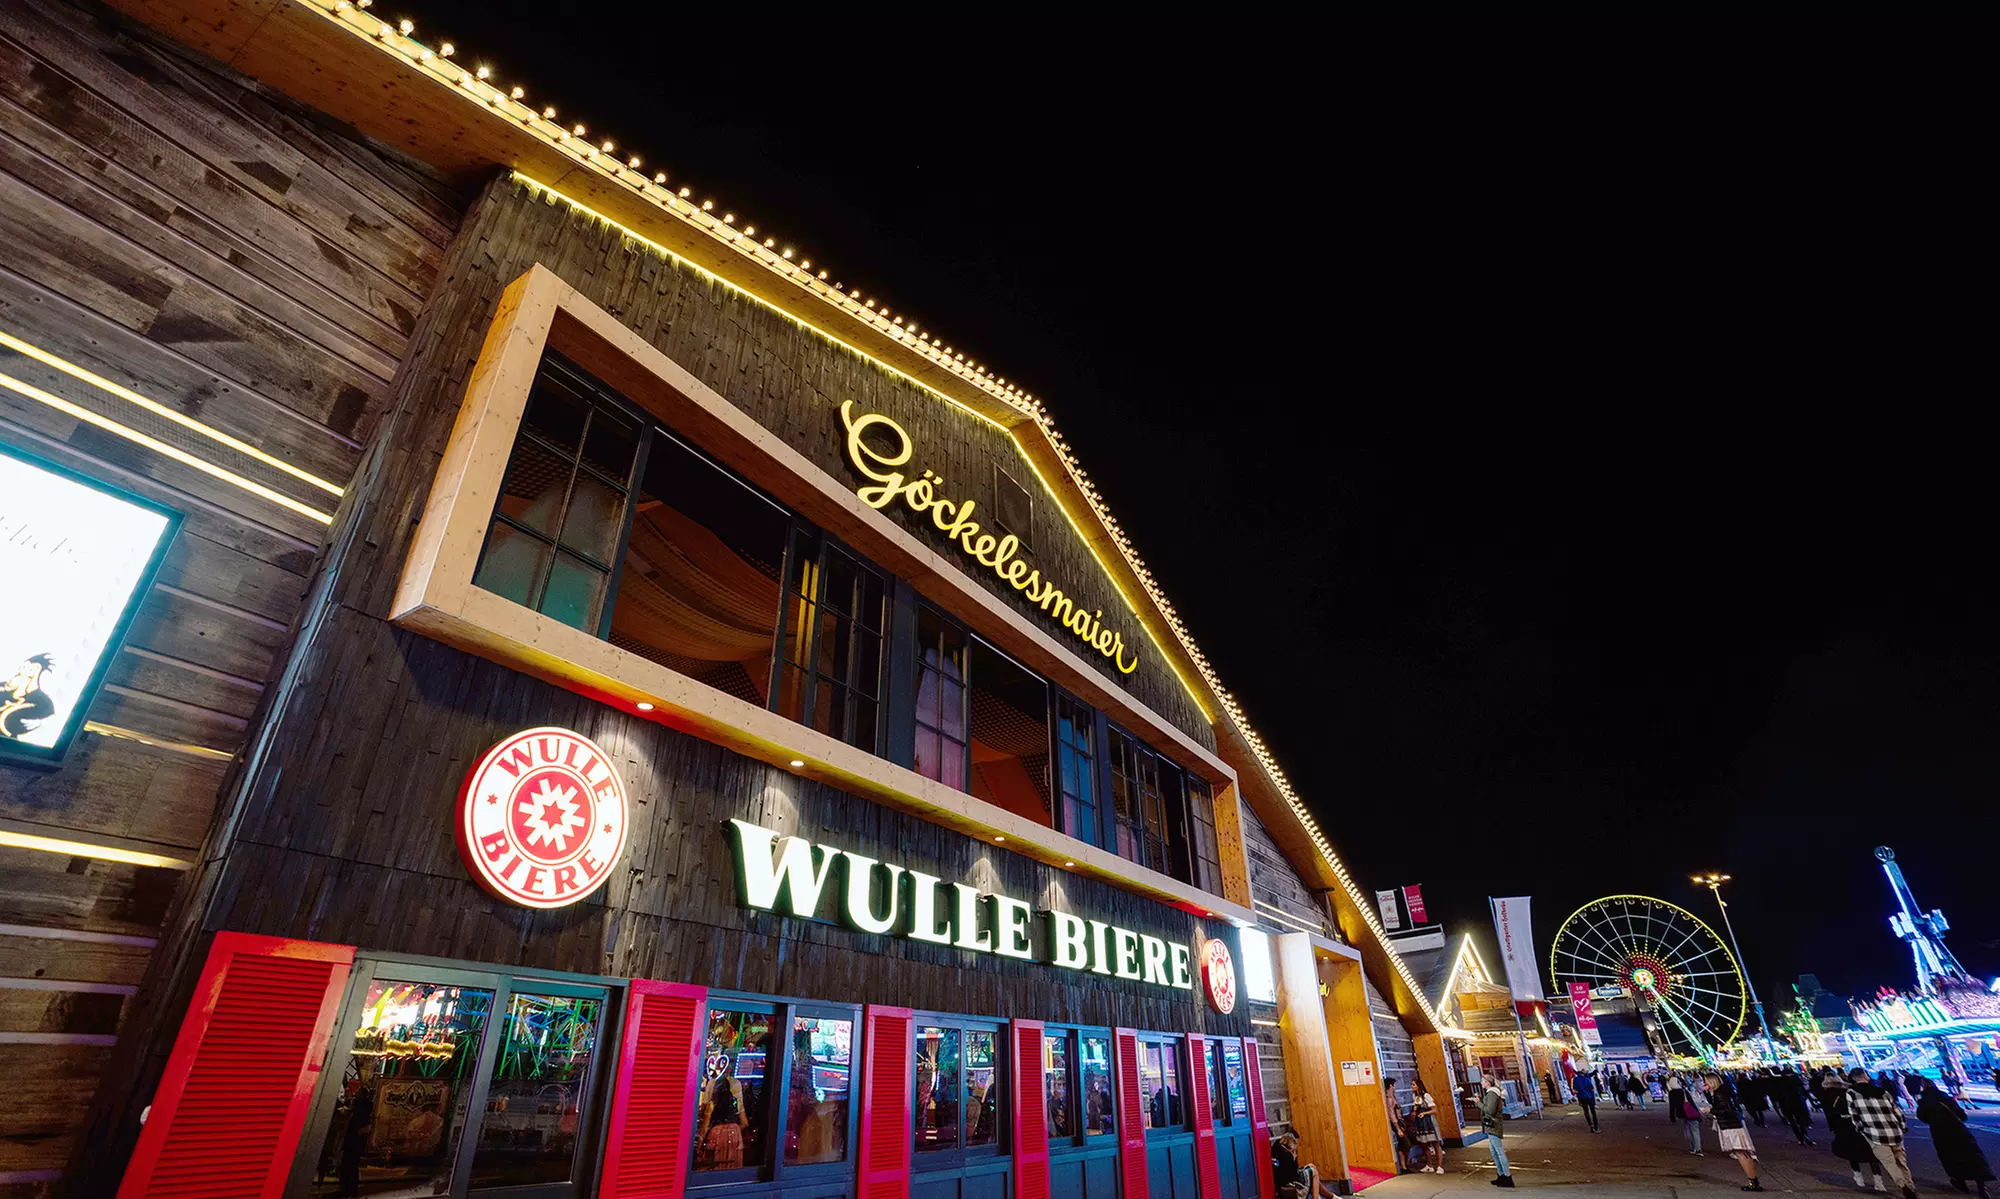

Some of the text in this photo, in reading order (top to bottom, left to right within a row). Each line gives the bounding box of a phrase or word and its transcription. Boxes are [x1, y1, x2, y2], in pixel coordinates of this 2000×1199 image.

[841, 400, 1138, 674] Göckelesmaier
[496, 738, 617, 802] WULLE
[480, 828, 604, 895] BIERE
[728, 818, 1193, 990] WULLE BIERE
